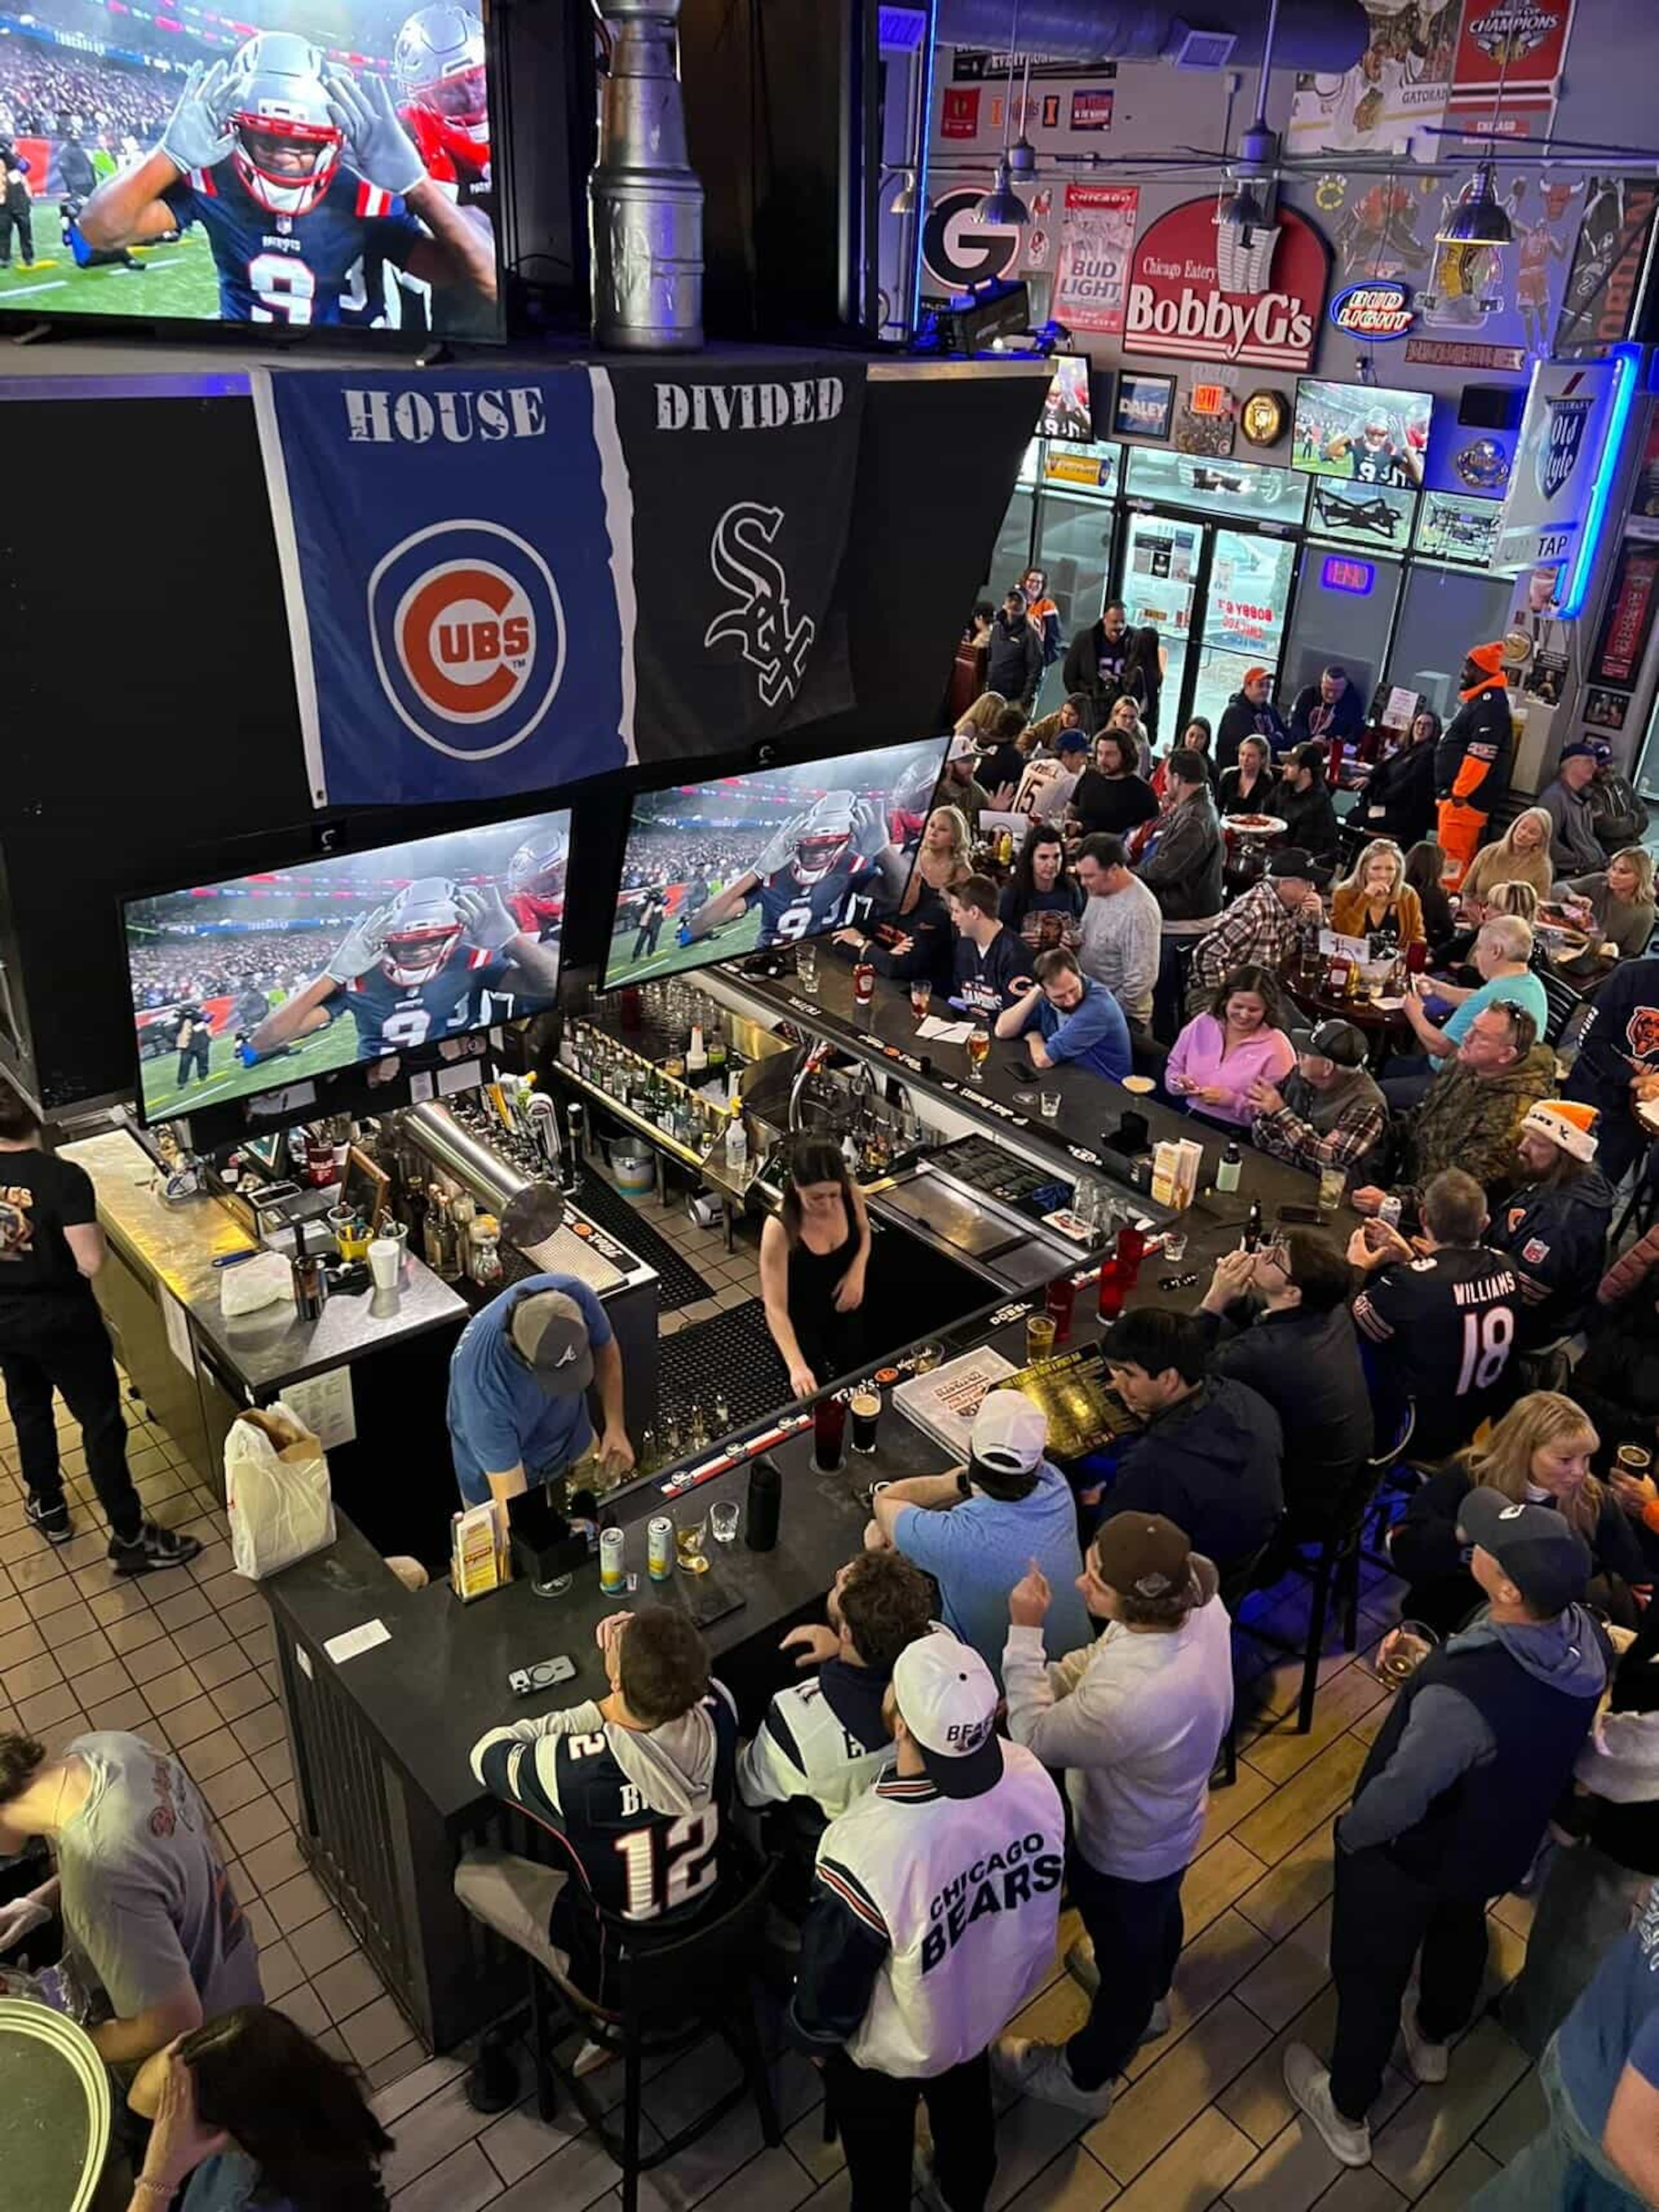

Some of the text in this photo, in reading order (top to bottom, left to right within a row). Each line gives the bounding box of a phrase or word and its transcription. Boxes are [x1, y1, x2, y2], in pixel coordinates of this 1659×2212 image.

[1469, 15, 1558, 33] CHAMPIONS
[1072, 261, 1117, 278] BUD
[1143, 257, 1217, 283] Chicago Eatery
[1059, 279, 1122, 298] LIGHT
[1349, 290, 1404, 310] BUD
[1337, 308, 1413, 331] LIGHT
[341, 377, 844, 443] HOUSE DIVIDED
[1551, 414, 1579, 445] Old
[1538, 536, 1567, 557] TAP
[1452, 1271, 1516, 1306] WILLIAMS
[1455, 1306, 1514, 1396] 18
[614, 1801, 719, 1921] 12
[930, 1832, 1044, 1921] CHICAGO
[922, 1853, 1062, 1975] BEARS
